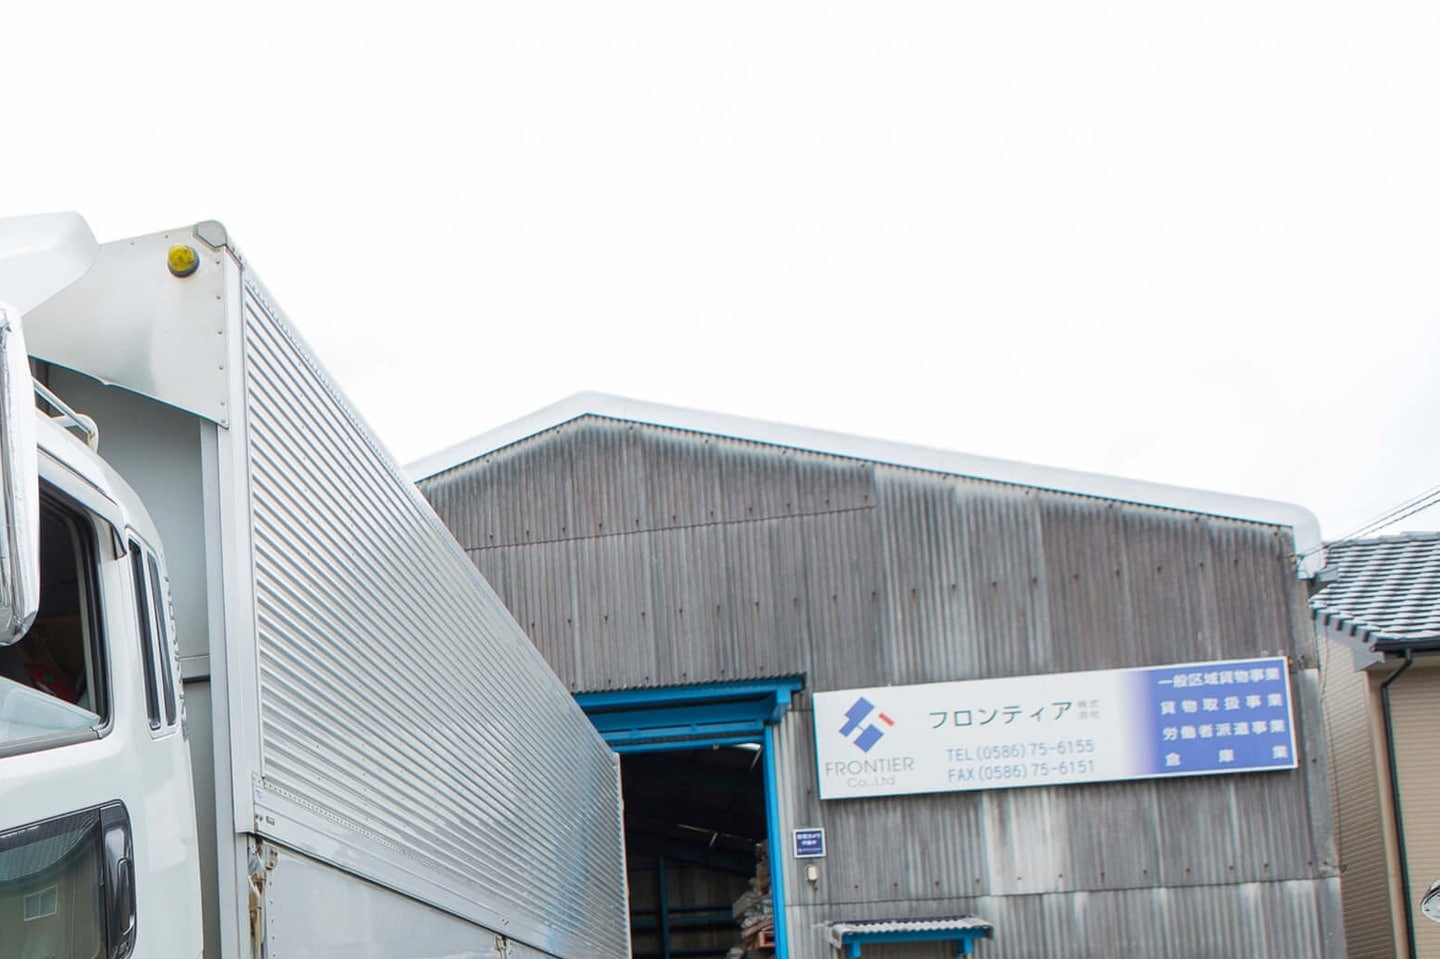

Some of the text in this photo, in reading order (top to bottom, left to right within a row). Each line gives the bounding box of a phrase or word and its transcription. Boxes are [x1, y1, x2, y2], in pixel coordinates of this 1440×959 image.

[928, 701, 1072, 729] フロンティア
[825, 757, 915, 776] FRONTIER
